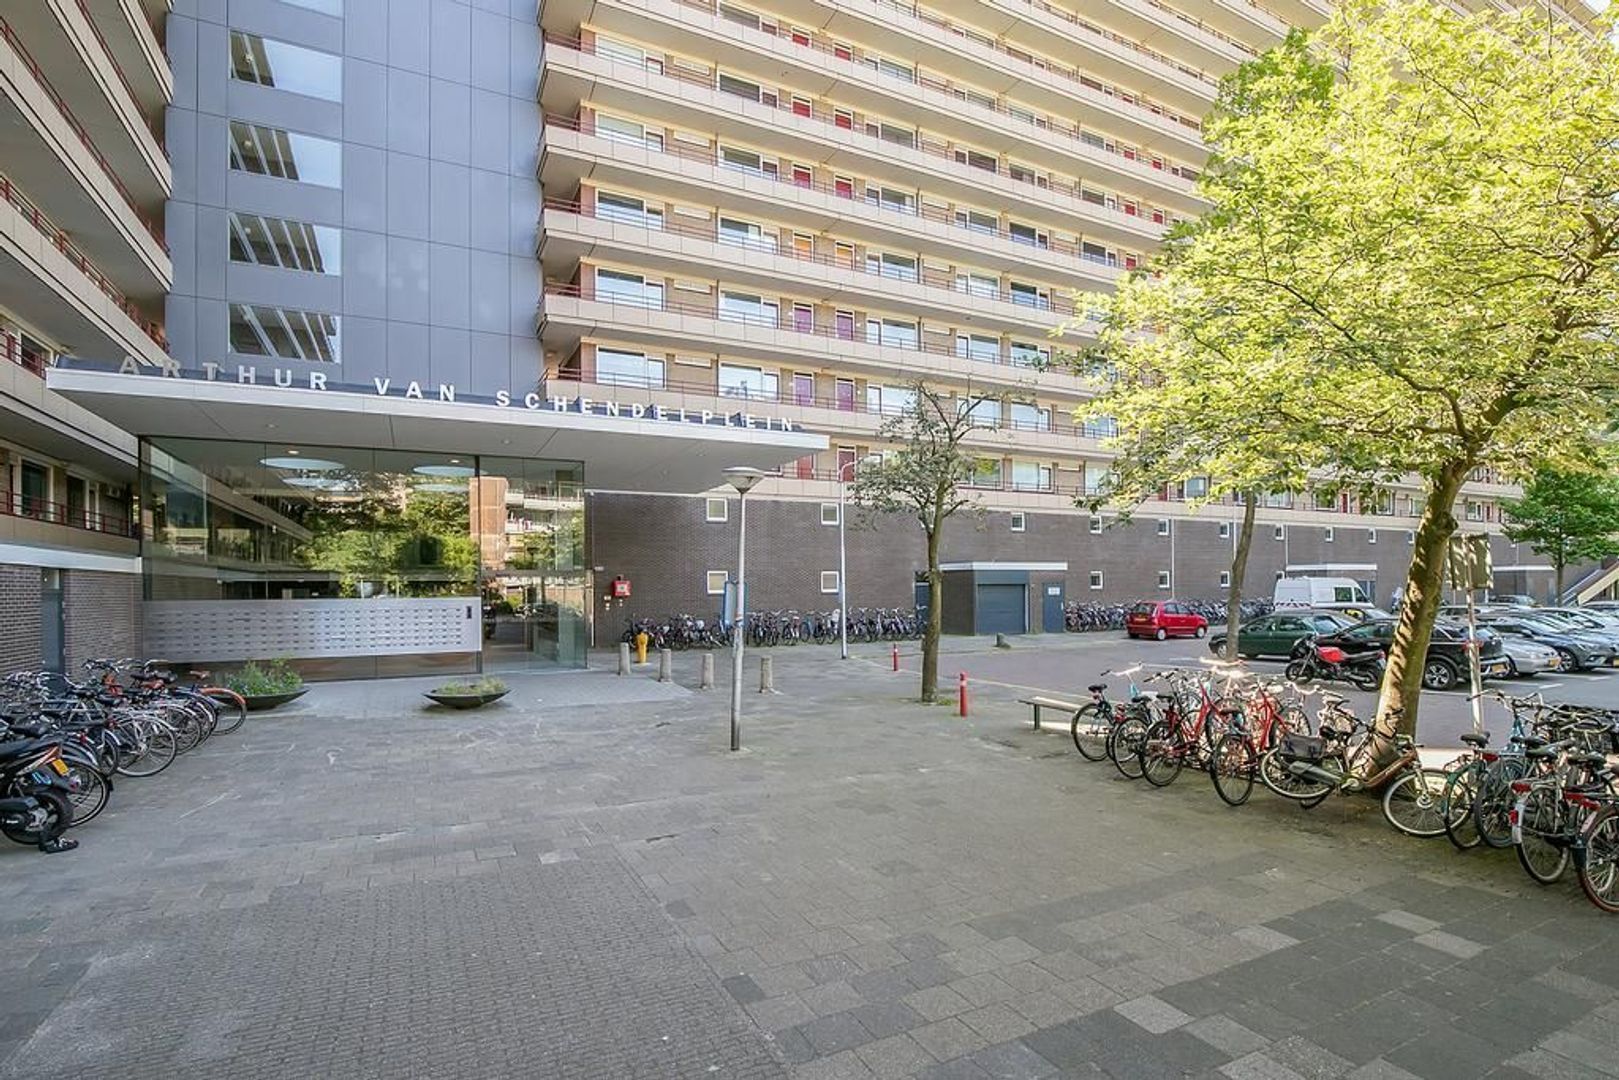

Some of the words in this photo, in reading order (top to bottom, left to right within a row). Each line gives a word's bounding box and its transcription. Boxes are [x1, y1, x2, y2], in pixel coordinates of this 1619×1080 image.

[118, 356, 328, 391] ARTHUR
[374, 377, 456, 402] VAN
[495, 390, 793, 431] SCHENDELPLEIN
